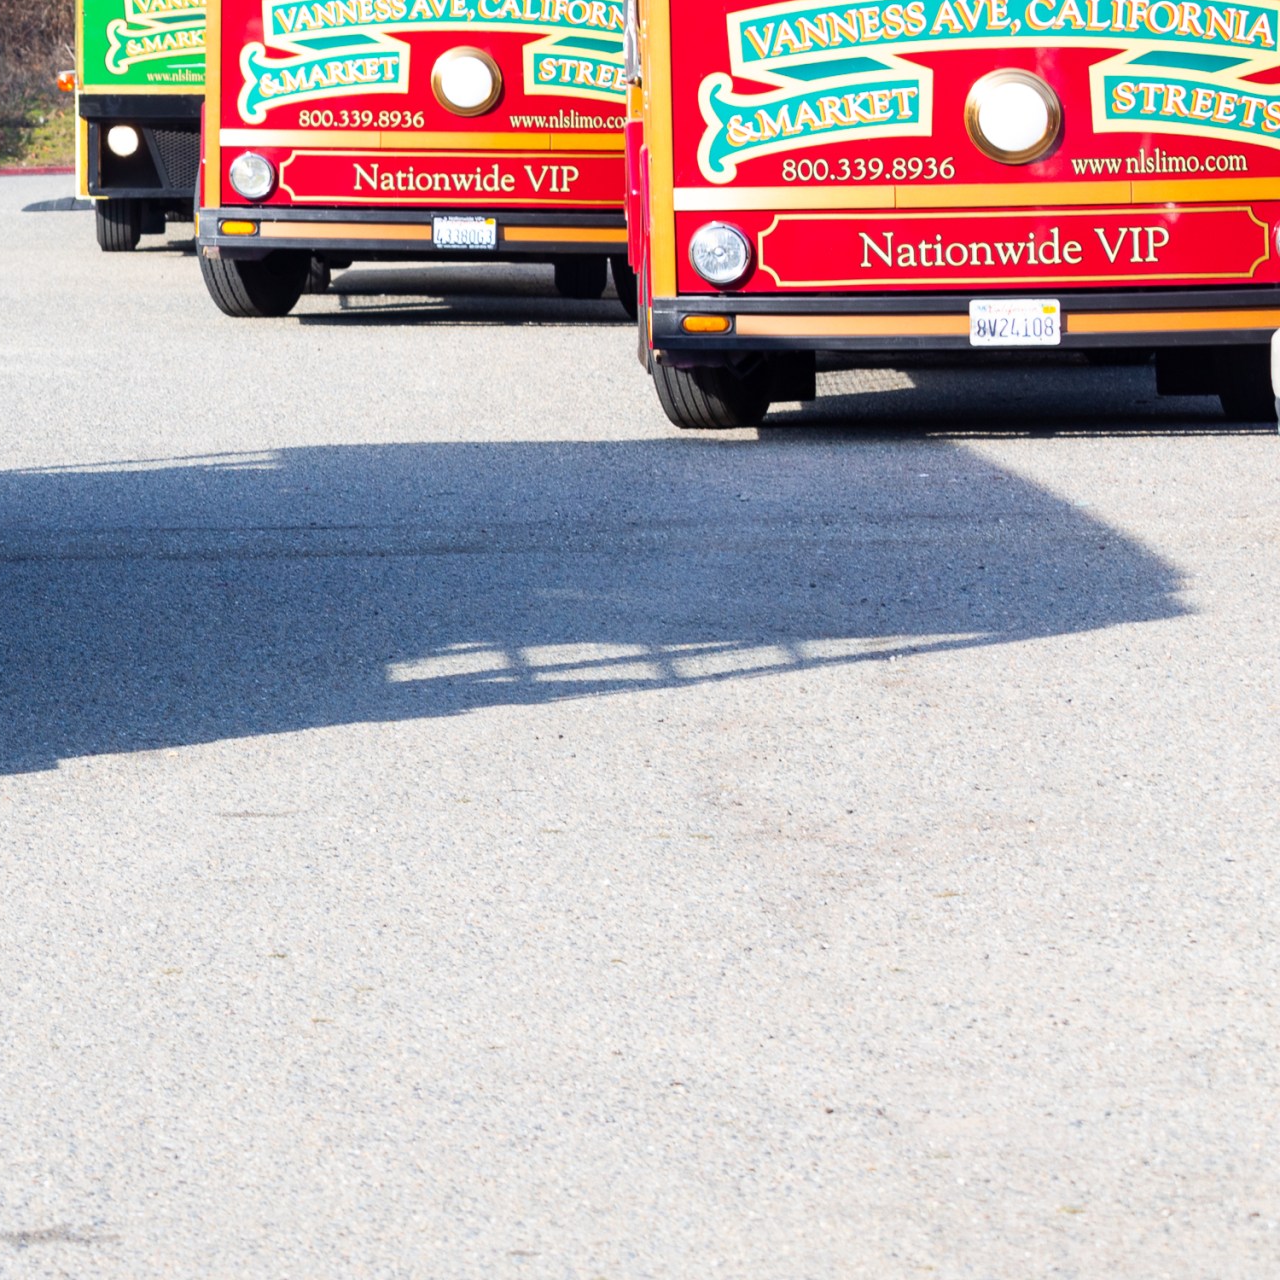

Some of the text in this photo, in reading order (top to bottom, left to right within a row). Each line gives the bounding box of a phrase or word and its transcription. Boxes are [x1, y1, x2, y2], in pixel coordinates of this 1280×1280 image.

[298, 109, 426, 129] 800.339.8936
[509, 108, 628, 129] www.nlslimo.co
[1111, 81, 1280, 133] STREETS
[352, 163, 580, 193] Nationwide VIP
[781, 156, 956, 182] 800.339.8936
[858, 226, 1170, 268] Nationwide VIP
[976, 317, 1054, 338] 8V24108
